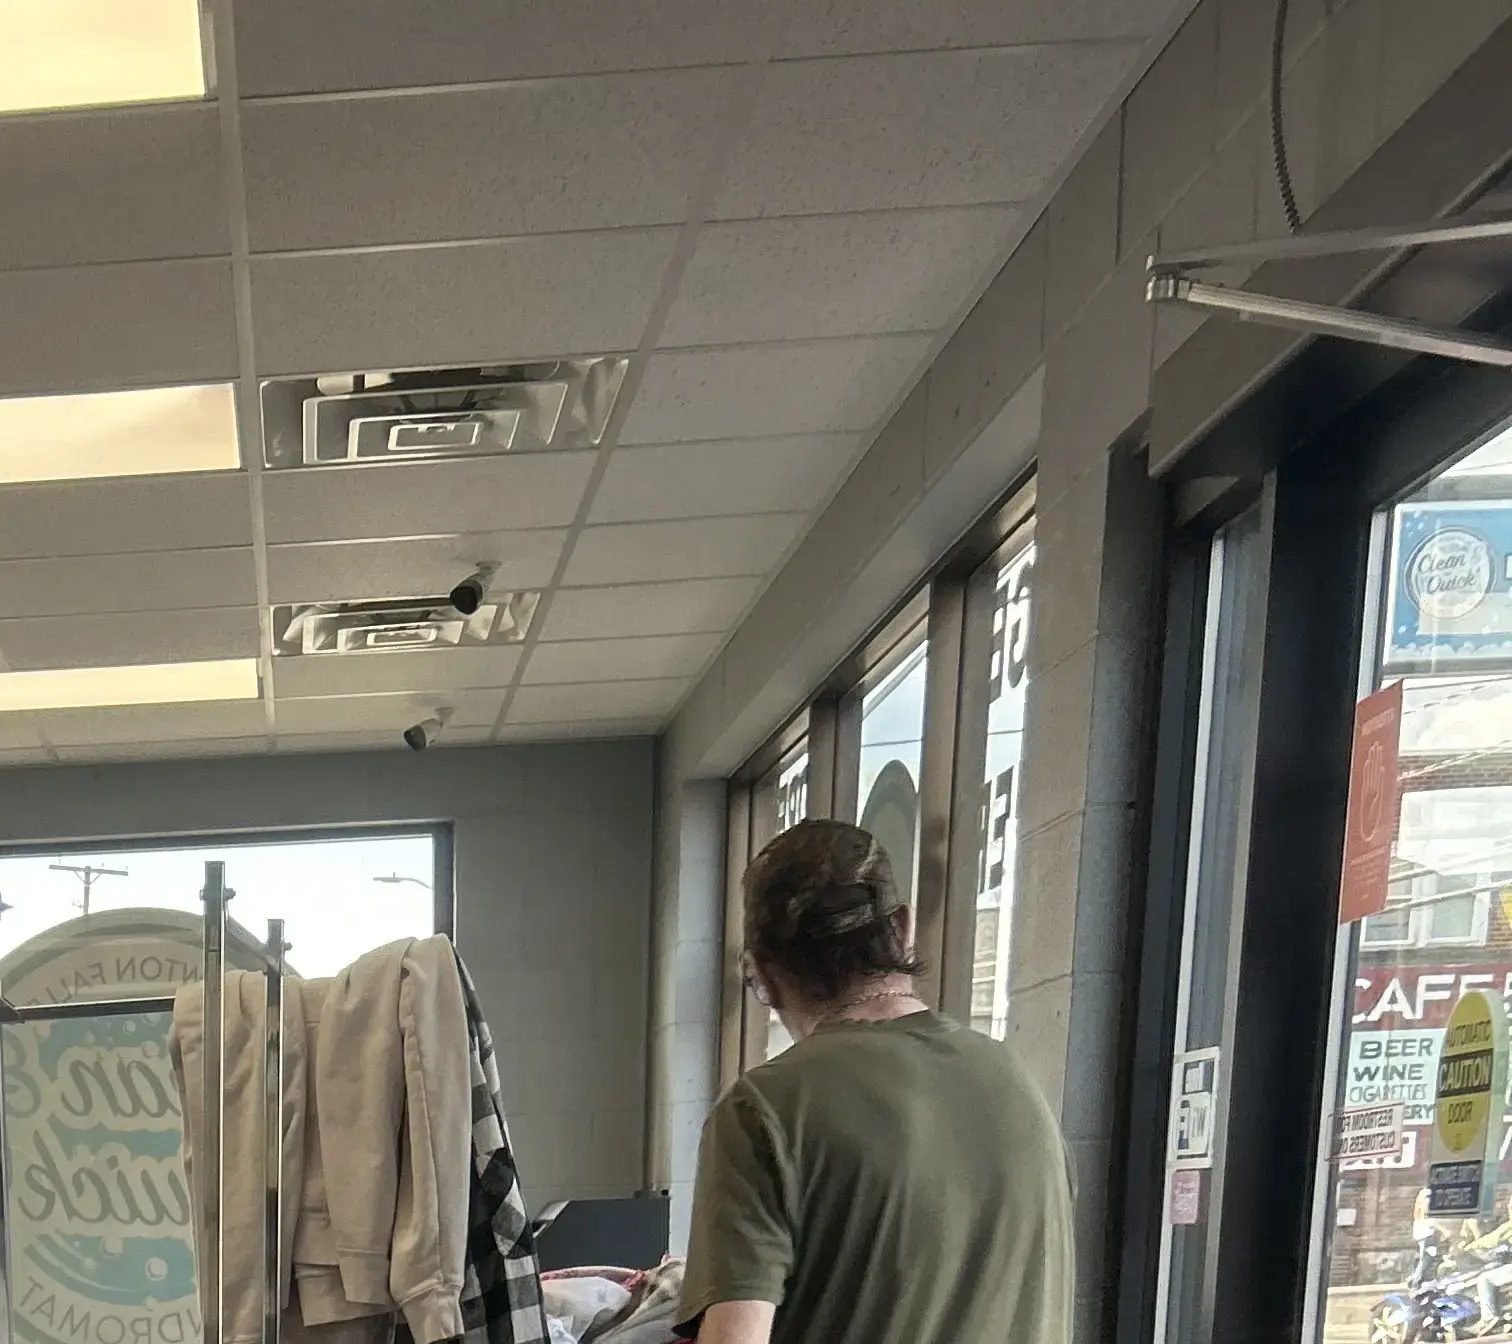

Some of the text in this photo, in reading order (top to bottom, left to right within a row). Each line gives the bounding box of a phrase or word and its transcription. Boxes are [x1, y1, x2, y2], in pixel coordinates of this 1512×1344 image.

[1417, 552, 1467, 574] Clean
[1359, 1037, 1433, 1060] BEER
[1353, 1063, 1425, 1082] WINE
[1439, 1055, 1489, 1092] CAUTION
